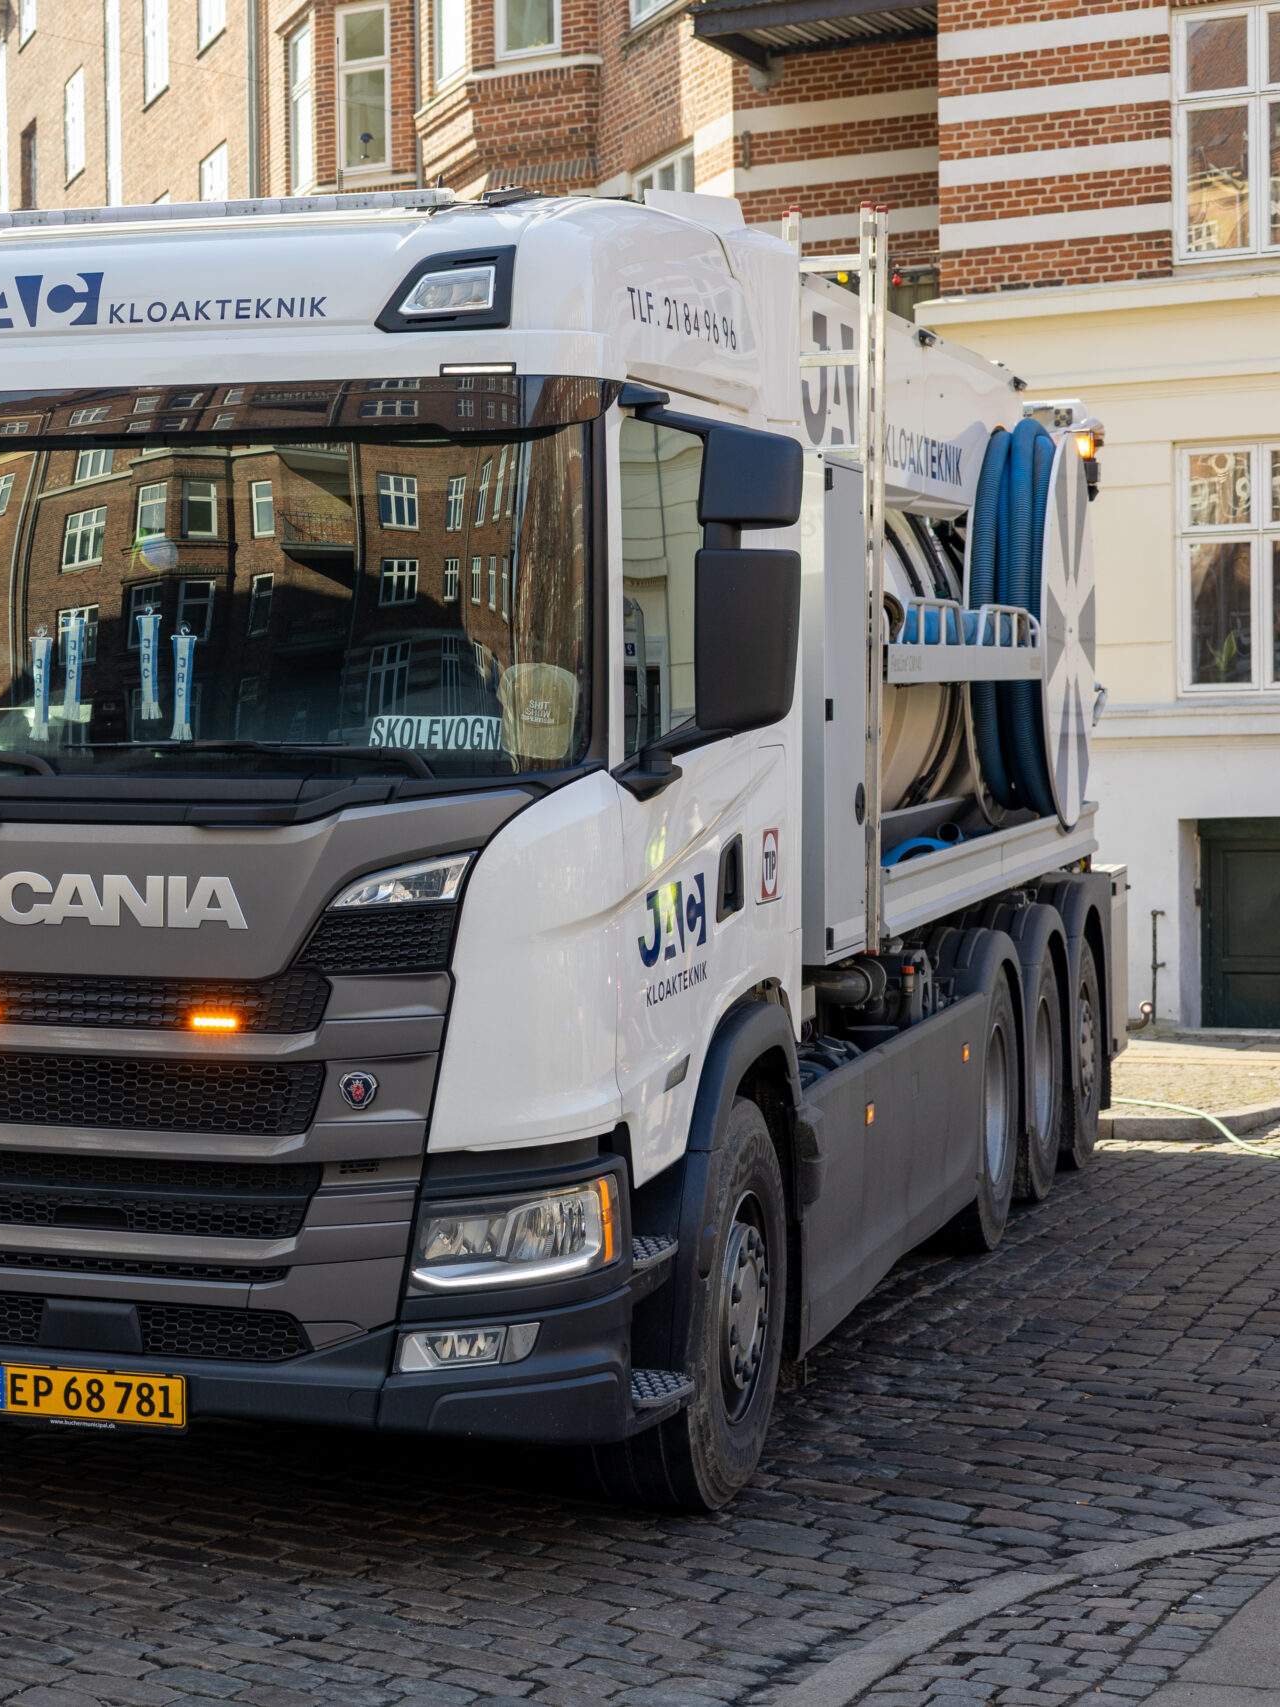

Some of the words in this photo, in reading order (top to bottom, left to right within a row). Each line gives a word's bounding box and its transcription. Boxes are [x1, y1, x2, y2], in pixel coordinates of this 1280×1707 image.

[109, 296, 328, 325] KLOAKTEKNIK
[627, 286, 660, 326] TLF.
[664, 297, 680, 332] 21
[683, 303, 700, 338] 84
[704, 309, 720, 344] 96
[722, 316, 737, 350] 96
[884, 424, 963, 486] KLOAKTEKNIK
[525, 707, 551, 718] SHOW
[529, 700, 551, 710] SHIT
[371, 717, 501, 750] SKOLEVOGN
[764, 850, 777, 881] TIP
[638, 872, 707, 968] JAC
[646, 961, 708, 1007] KLOAKTEKNIK
[10, 1373, 53, 1407] EP
[64, 1376, 106, 1413] 68
[114, 1381, 175, 1419] 781
